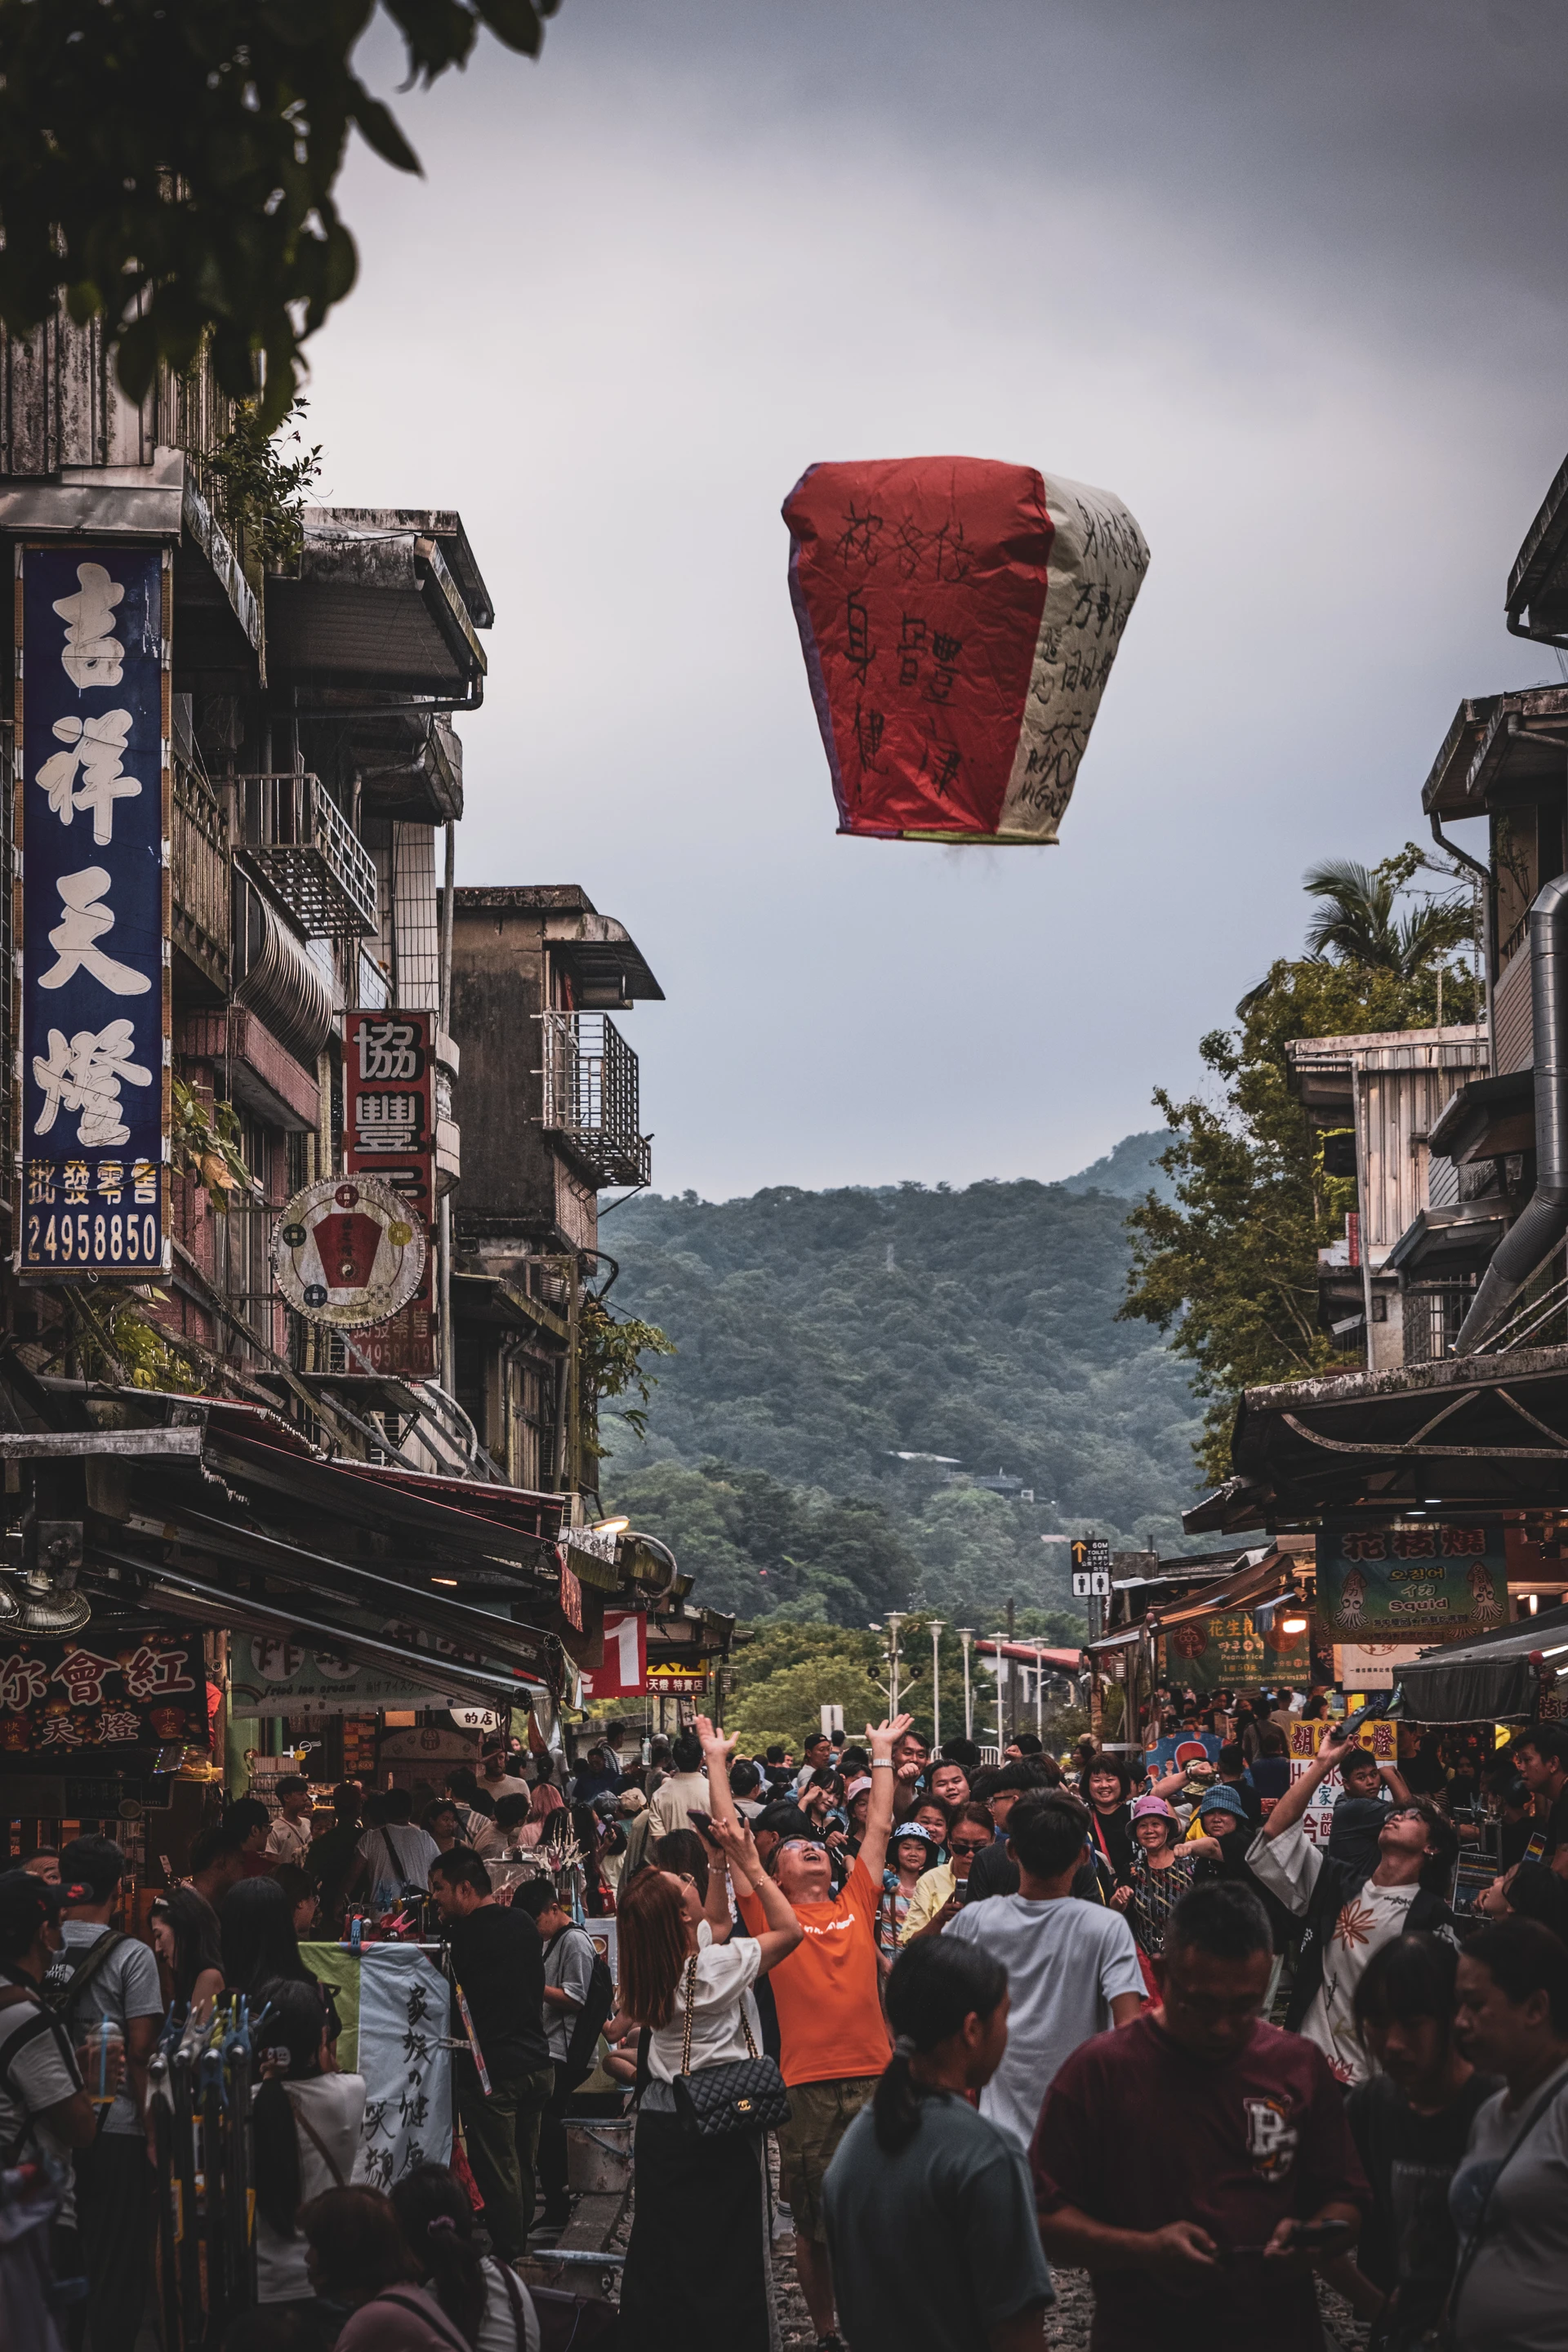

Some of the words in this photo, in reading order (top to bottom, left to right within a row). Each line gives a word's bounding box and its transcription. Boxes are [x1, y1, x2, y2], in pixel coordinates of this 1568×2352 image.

[33, 562, 153, 1147] 吉祥天燈
[28, 1158, 157, 1205] 批發零售
[28, 1214, 156, 1261] 24958850
[1389, 1566, 1447, 1581] 오징어
[1401, 1584, 1437, 1597] イカ
[1389, 1597, 1449, 1613] Squid
[646, 1678, 670, 1691] 天燈
[4, 1721, 21, 1744] 快樂
[42, 1711, 141, 1745] 天燈
[160, 1708, 176, 1733] 平安
